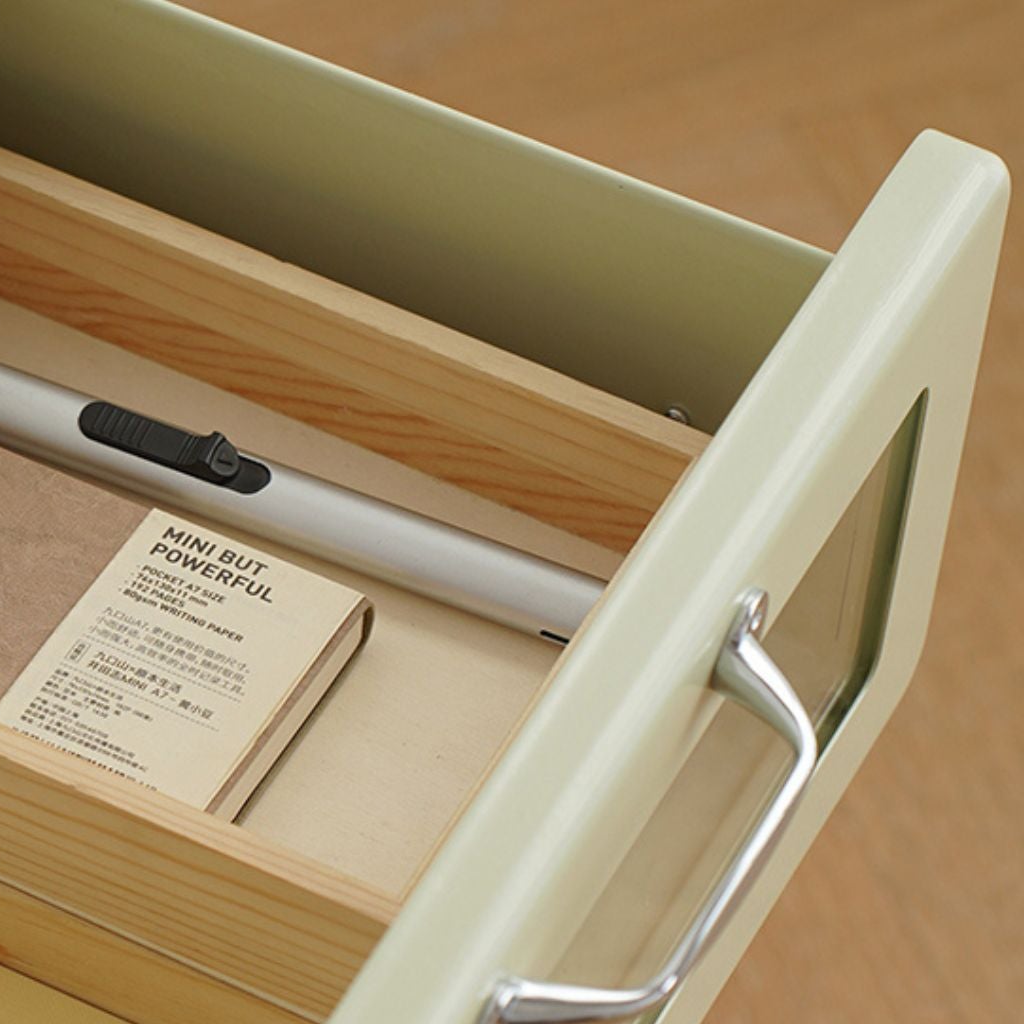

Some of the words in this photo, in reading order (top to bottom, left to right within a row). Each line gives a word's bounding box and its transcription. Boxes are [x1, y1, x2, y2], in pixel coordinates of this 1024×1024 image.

[149, 542, 275, 603] POWERFUL
[161, 525, 217, 556] MINI
[217, 548, 268, 577] BUT
[129, 579, 151, 593] 192
[149, 588, 186, 608] PAGES
[141, 564, 185, 587] POCKET
[185, 582, 202, 594] A7
[199, 589, 226, 604] SIZE
[187, 595, 209, 607] mm
[121, 587, 159, 608] 80gsm
[157, 602, 206, 627] WRITING
[205, 622, 244, 643] PAPER
